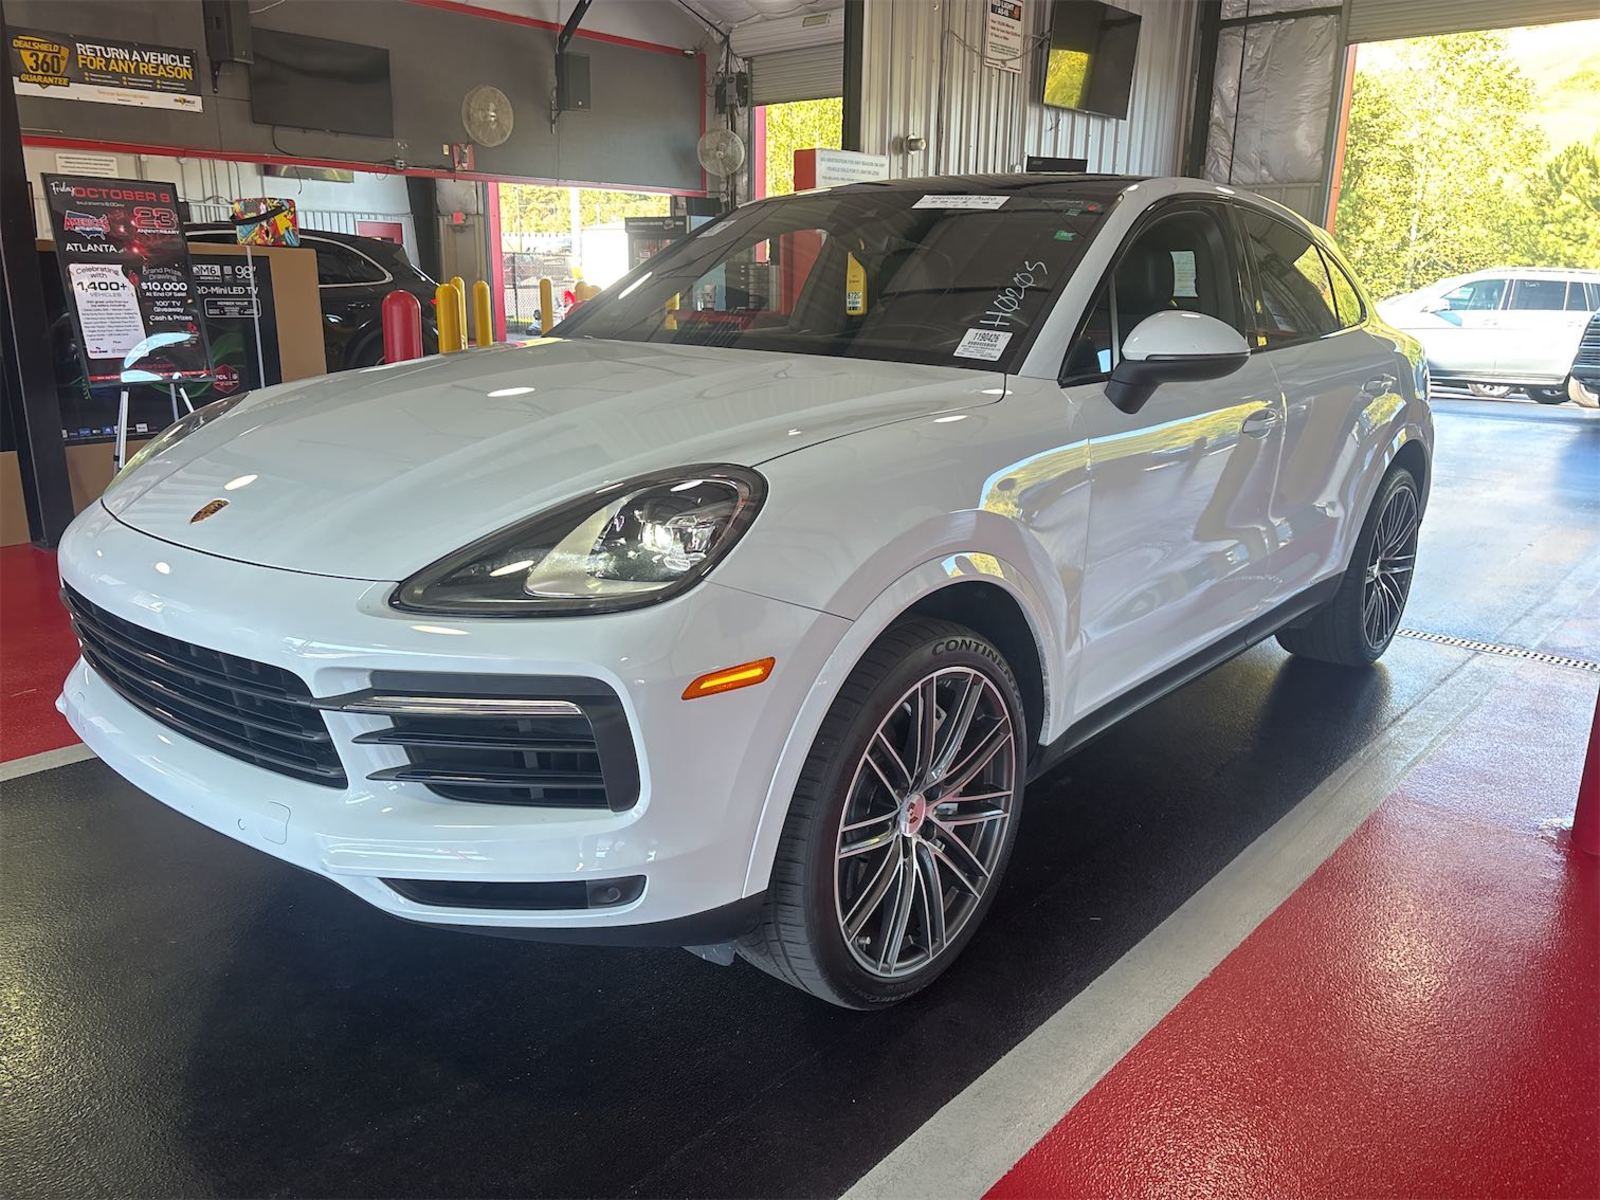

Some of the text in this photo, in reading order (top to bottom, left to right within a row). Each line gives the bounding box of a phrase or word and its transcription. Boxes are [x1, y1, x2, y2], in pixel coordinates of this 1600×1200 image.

[13, 38, 60, 52] DEALSHIELD
[75, 43, 192, 68] RETURN A VEHICLE
[77, 55, 193, 80] FOR ANY REASON
[20, 73, 70, 86] GUARANTEE
[50, 181, 171, 203] Friday OCTOBER 9
[65, 242, 118, 254] ATLANTA
[75, 265, 120, 277] Celebrating
[143, 264, 183, 276] Grand Prize
[76, 281, 128, 293] 1,400+
[141, 282, 188, 292] $10,000
[228, 286, 245, 295] LED
